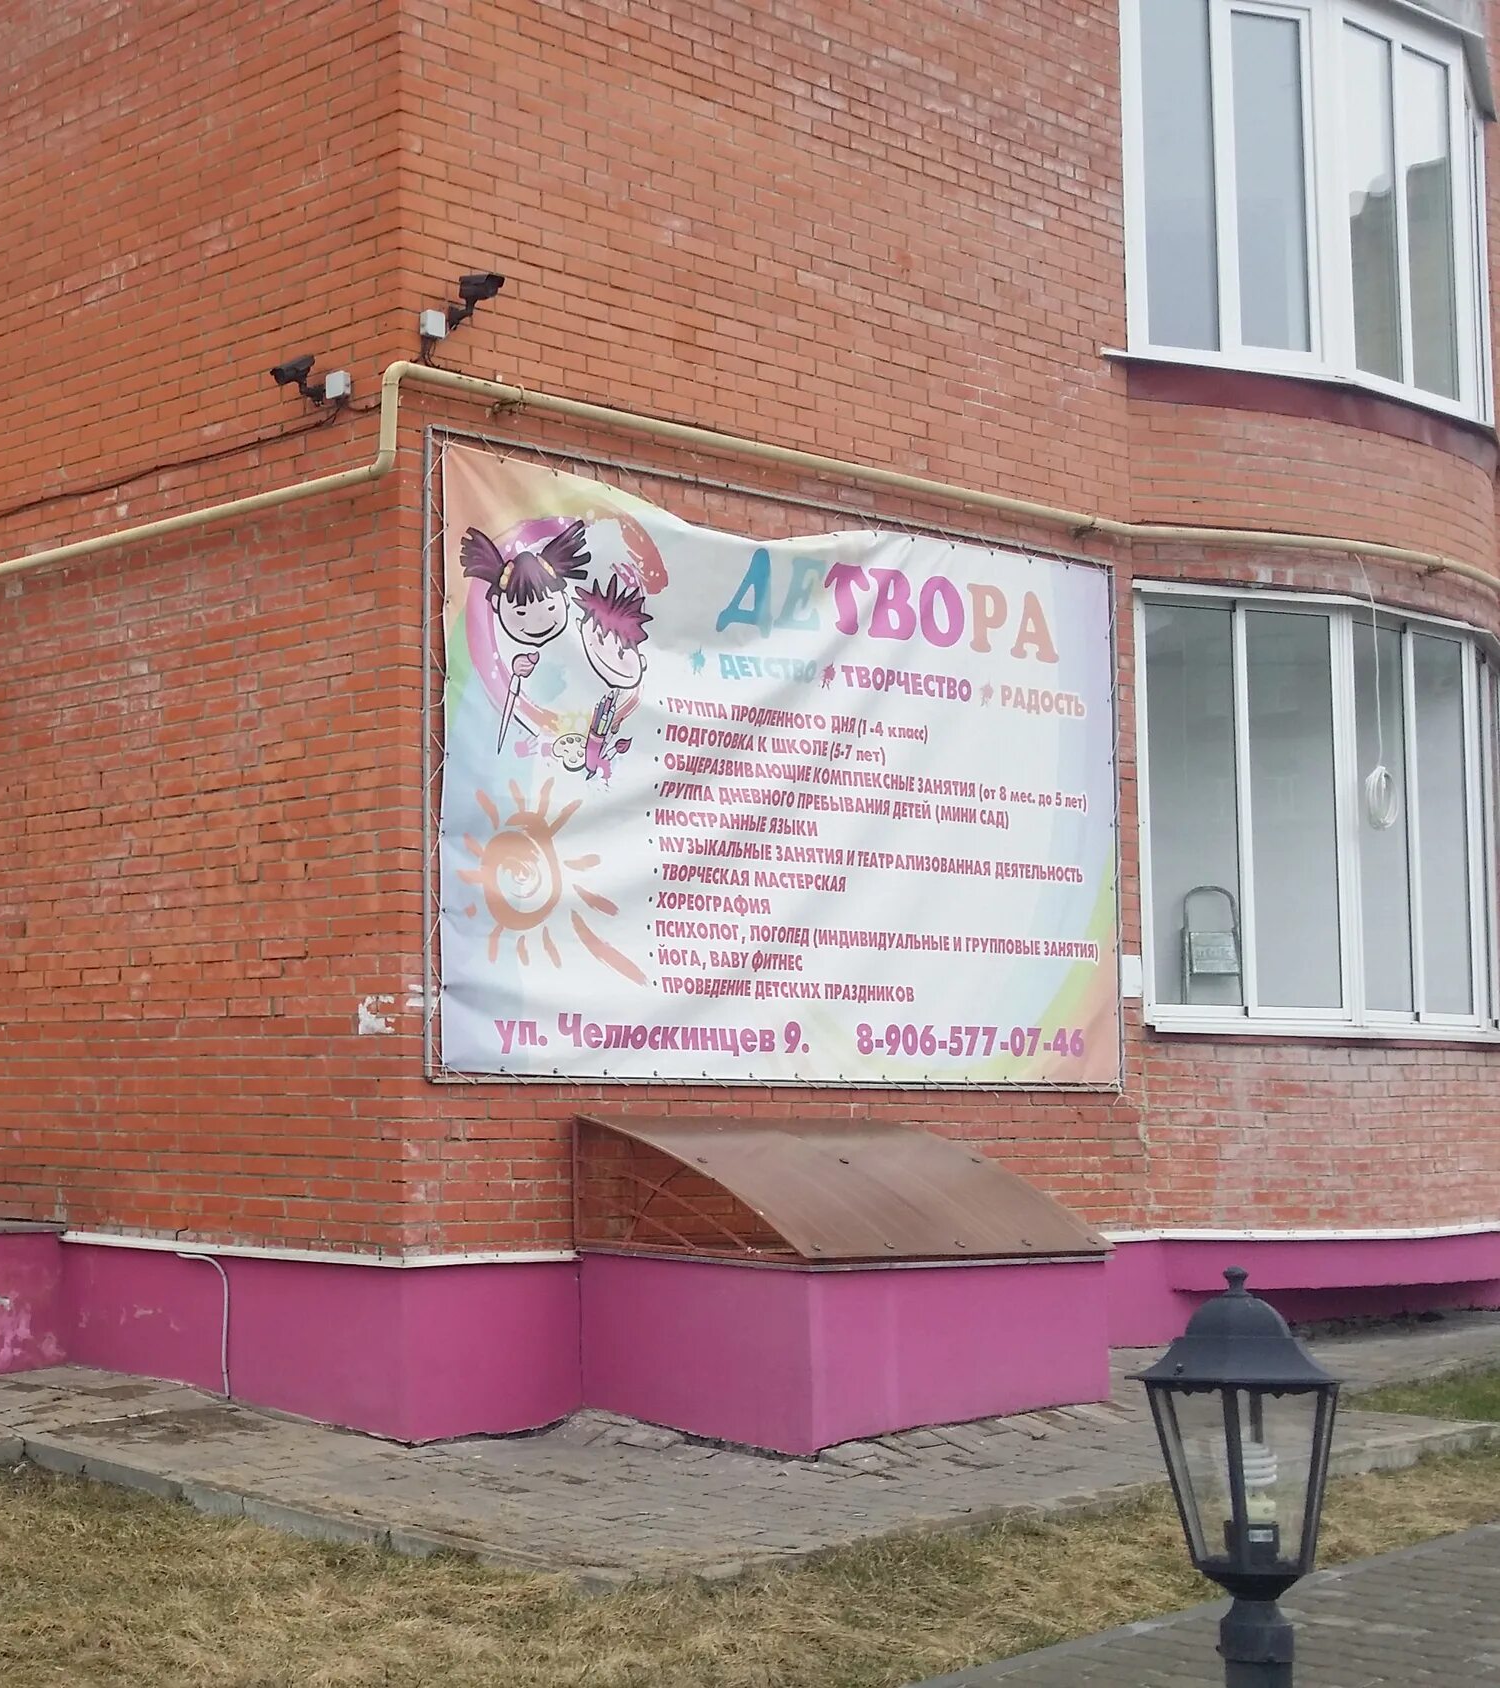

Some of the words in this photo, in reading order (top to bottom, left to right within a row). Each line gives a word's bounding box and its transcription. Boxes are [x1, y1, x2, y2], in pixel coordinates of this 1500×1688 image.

[716, 547, 1059, 663] ДЕТВОРА
[718, 653, 818, 683] ДЕТСТВО
[841, 664, 972, 702] ТВОРЧЕСТВО
[1001, 685, 1086, 717] РАДОСТЬ
[666, 697, 728, 720] ГРУППА
[731, 704, 827, 730] ПРОДЛЕННОГО
[831, 715, 856, 735] ДНЯ
[888, 725, 928, 744] класс)
[665, 723, 754, 751] ПОДГОТОВКА
[758, 736, 768, 753] К
[771, 738, 828, 757] ШКОЛЕ
[856, 747, 886, 766] лет)
[664, 752, 812, 783] ОБЩЕРАЗВИВАЮЩИЕ
[813, 766, 915, 792] КОМПЛЕКСНЫЕ
[918, 777, 975, 798] ЗАНЯТИЯ
[979, 783, 996, 802] (от
[999, 786, 1007, 801] 8
[1010, 791, 1035, 804] мес.
[1038, 794, 1052, 807] до
[1055, 791, 1062, 807] 5
[1065, 795, 1087, 812] лет)
[655, 808, 766, 833] ИНОСТРАННЫЕ
[769, 817, 819, 837] ЯЗЫКИ
[659, 780, 713, 802] ГРУППА
[718, 786, 794, 808] ДНЕВНОГО
[797, 792, 891, 816] ПРЕБЫВАНИЯ
[893, 800, 931, 820] ДЕТЕЙ
[935, 805, 977, 824] (МИНИ
[979, 810, 1010, 829] САД)
[659, 836, 772, 860] МУЗЫКАЛЬНЫЕ
[776, 844, 843, 865] ЗАНЯТИЯ
[846, 850, 855, 866] И
[857, 851, 991, 877] ТЕАТРАЛИЗОВАННАЯ
[995, 861, 1083, 883] ДЕЯТЕЛЬНОСТЬ
[662, 863, 750, 886] ТВОРЧЕСКАЯ
[754, 871, 846, 892] МАСТЕРСКАЯ
[656, 891, 771, 917] ХОРЕОГРАФИЯ
[658, 944, 707, 970] ЙОГА,
[751, 950, 803, 972] ФИТНЕС
[750, 925, 810, 947] ЛОГОПЕД
[813, 928, 949, 951] (ИНДИВИДУАЛЬНЫЕ
[953, 936, 962, 951] И
[965, 936, 1041, 956] ГРУППОВЫЕ
[1044, 941, 1099, 961] ЗАНЯТИЯ)
[661, 976, 752, 998] ПРОВЕДЕНИЕ
[755, 980, 821, 1000] ДЕТСКИХ
[824, 984, 915, 1003] ПРАЗДНИКОВ
[494, 1020, 548, 1054] ул.
[558, 1012, 776, 1057] Челюскинцев
[784, 1021, 810, 1054] 9.
[856, 1022, 1086, 1057] 8-906-577-07-46
